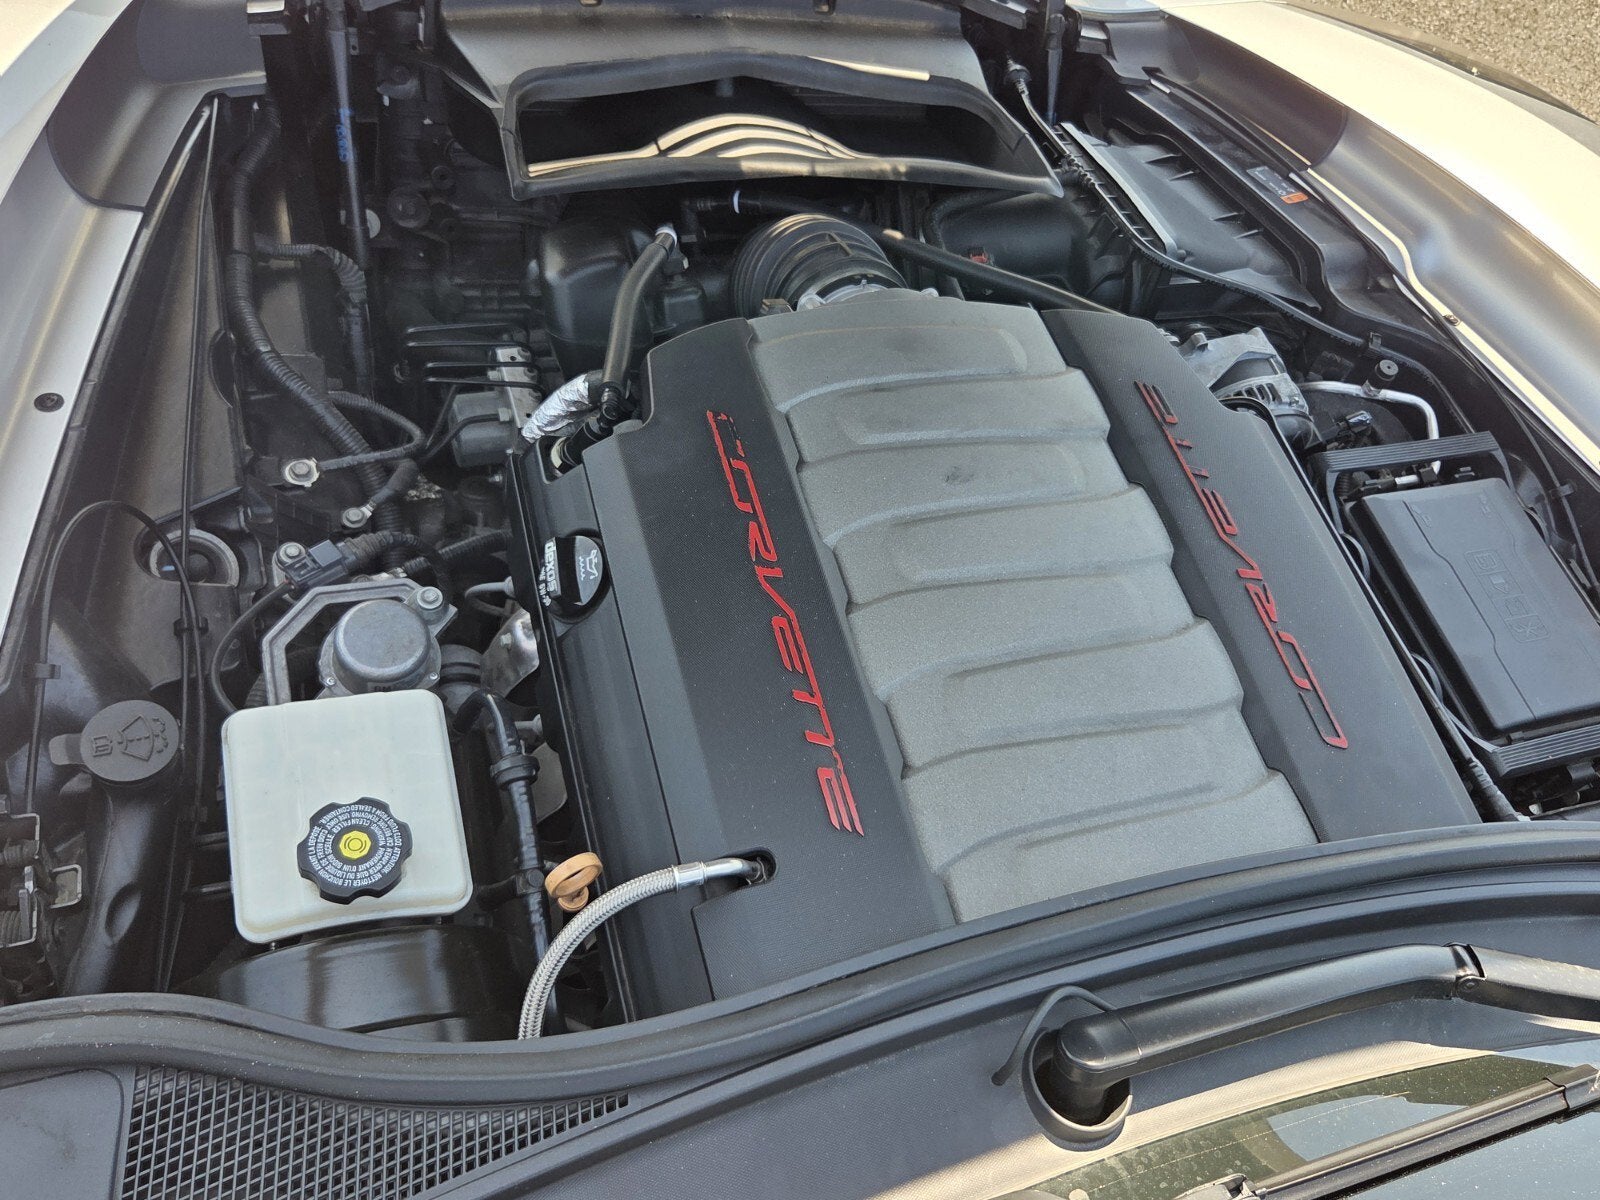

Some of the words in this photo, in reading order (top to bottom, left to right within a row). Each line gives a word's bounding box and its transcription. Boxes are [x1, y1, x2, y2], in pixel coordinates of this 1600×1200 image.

[545, 541, 558, 592] dexos
[1134, 380, 1348, 749] CORVETTE
[707, 410, 865, 837] CORVETTE
[350, 804, 372, 812] SEALED
[375, 809, 390, 821] FROM
[325, 817, 339, 830] ONLY
[338, 812, 350, 821] USE
[351, 818, 370, 826] CLEAN
[331, 819, 351, 834] FILLER
[378, 819, 393, 837] BEFORE
[387, 819, 400, 833] FLUID
[386, 836, 394, 847] CAP
[393, 832, 402, 846] DOT3
[320, 857, 329, 867] DE
[318, 869, 344, 886] BOUCHON
[353, 872, 382, 887] NETTOYER
[356, 871, 369, 879] QUE
